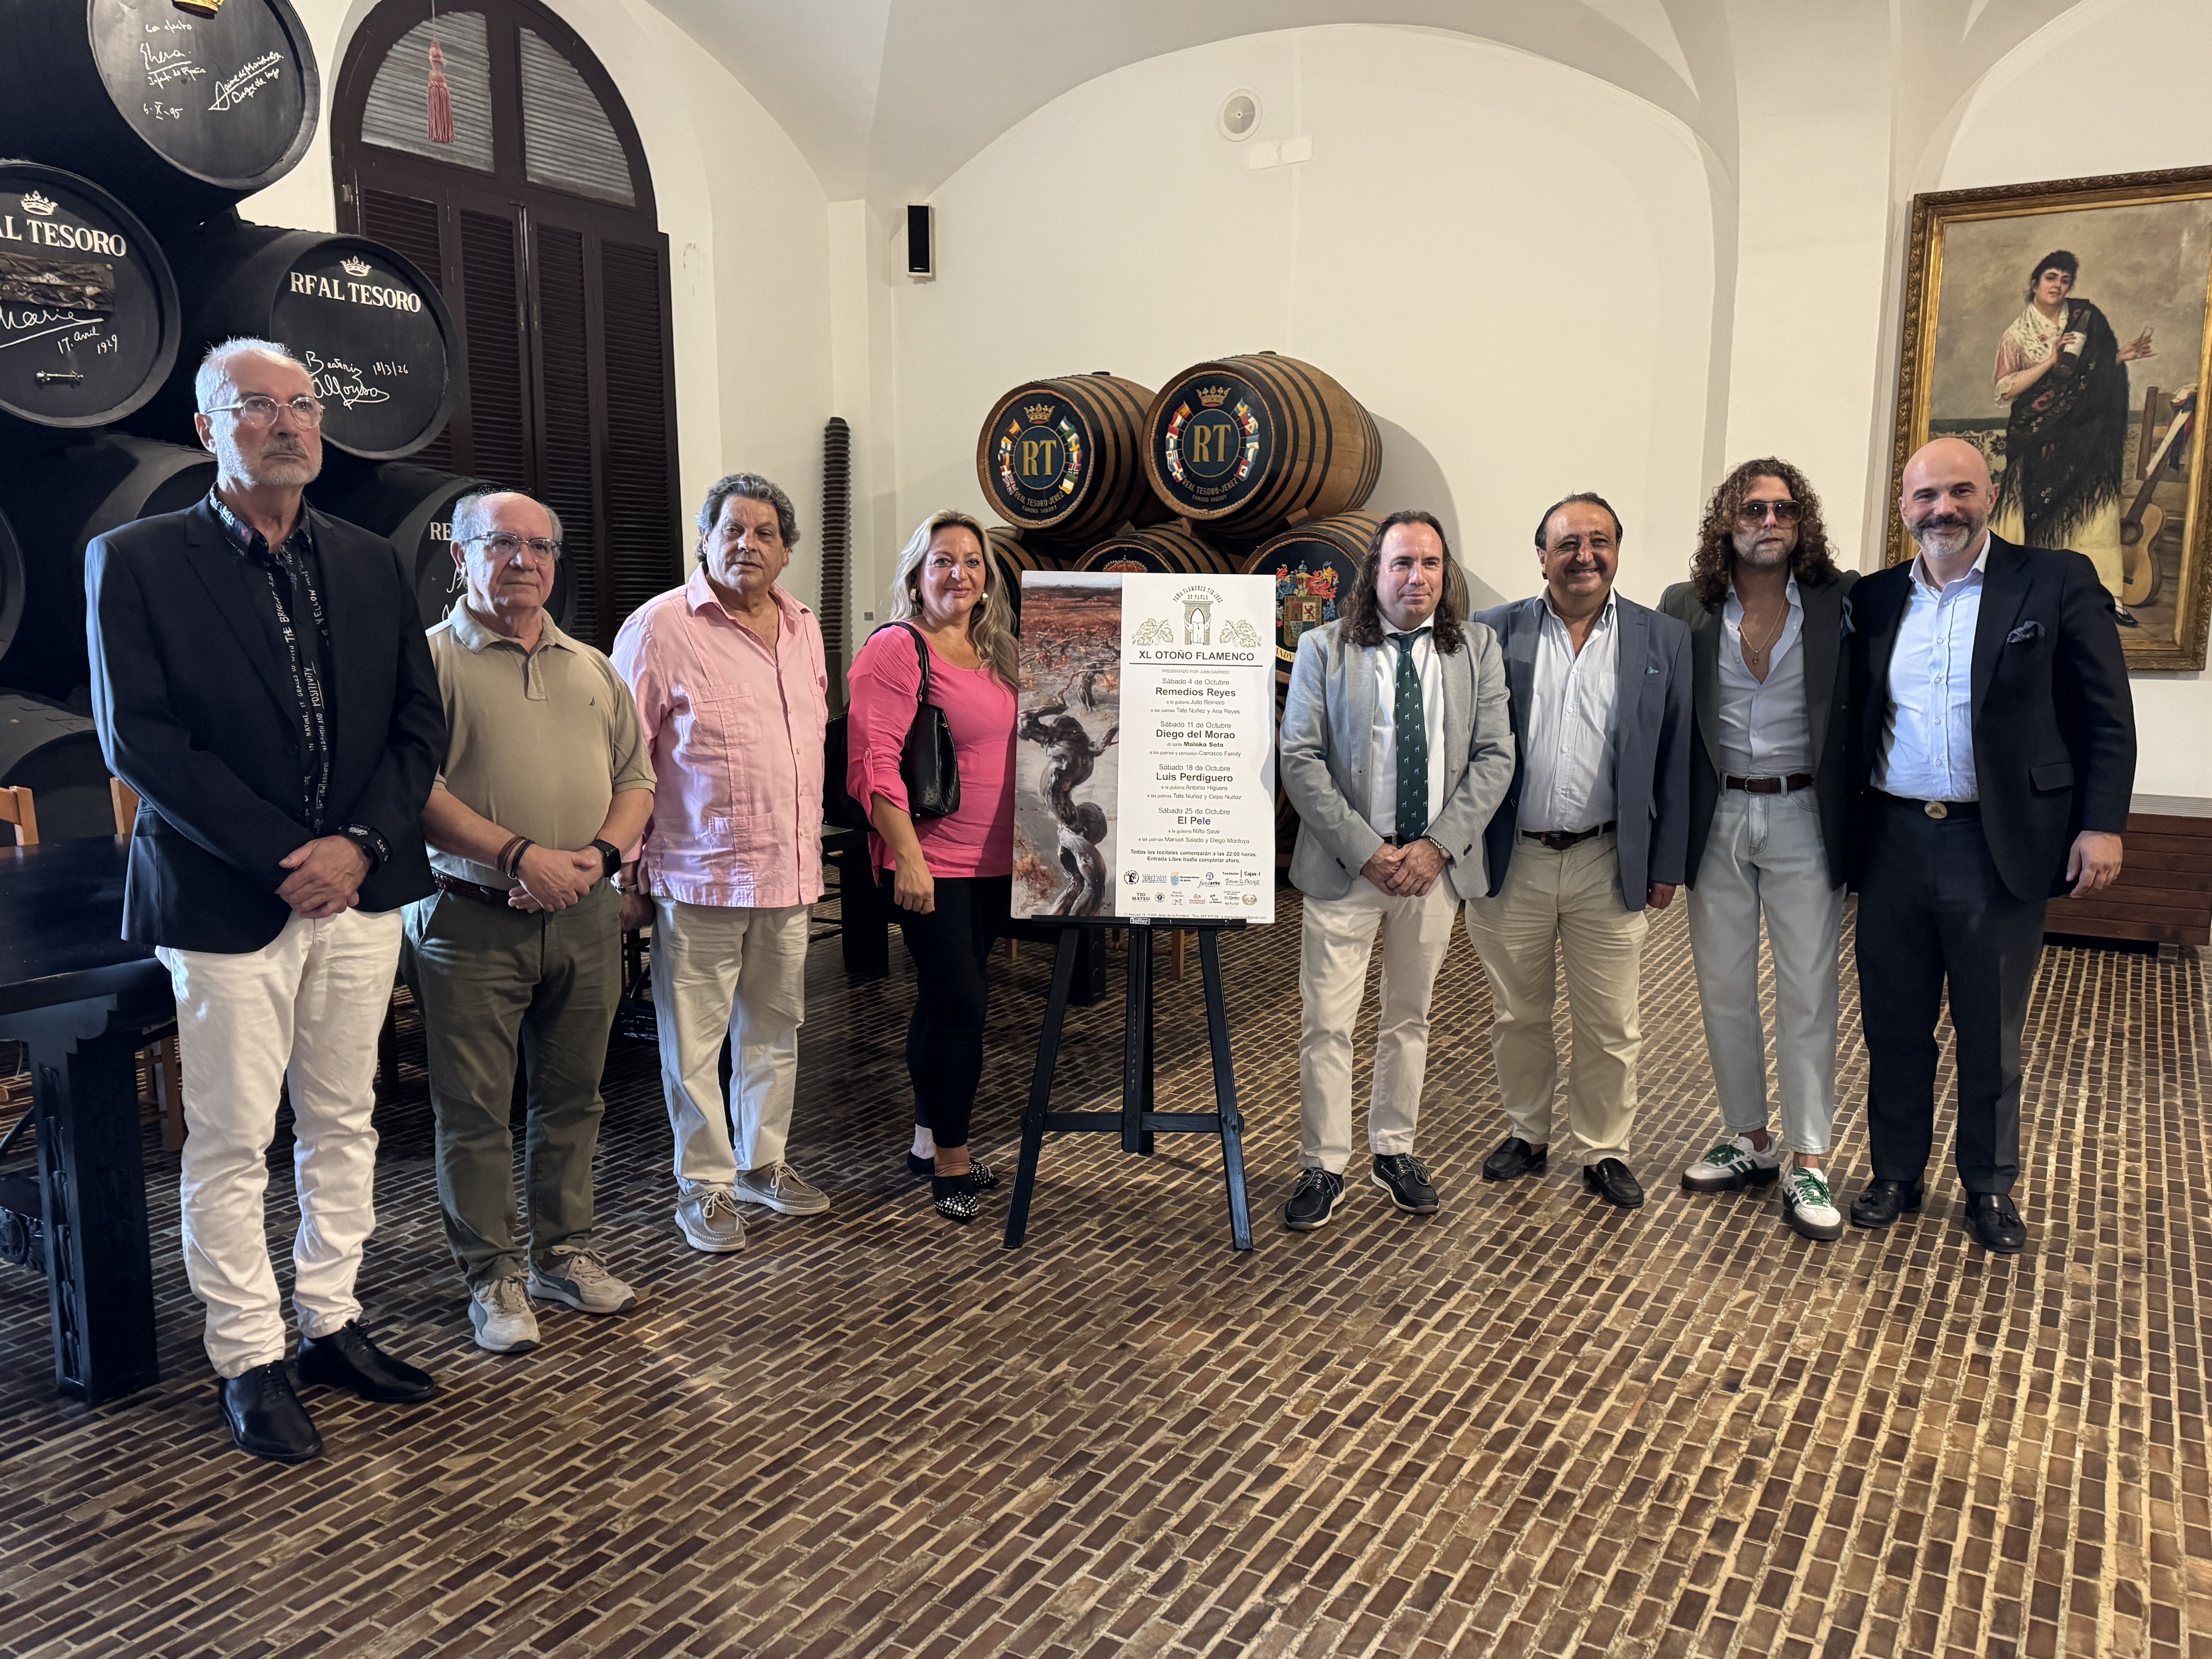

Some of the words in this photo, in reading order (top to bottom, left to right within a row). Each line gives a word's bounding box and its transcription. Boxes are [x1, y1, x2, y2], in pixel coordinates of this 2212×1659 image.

[26, 219, 127, 257] TESORO
[348, 283, 421, 313] TESORO
[1193, 424, 1231, 462] RT
[1022, 440, 1057, 476] RT
[430, 522, 453, 541] RE
[308, 589, 325, 625] YELLOW
[283, 626, 295, 643] THE
[1156, 650, 1192, 659] OTOÑO
[1197, 652, 1254, 661] FLAMENCO
[1156, 687, 1203, 696] Remedios
[1207, 689, 1235, 698] Reyes
[1156, 730, 1183, 739] Diego
[1157, 772, 1176, 780] Luis
[1180, 773, 1233, 783] Perdiguero
